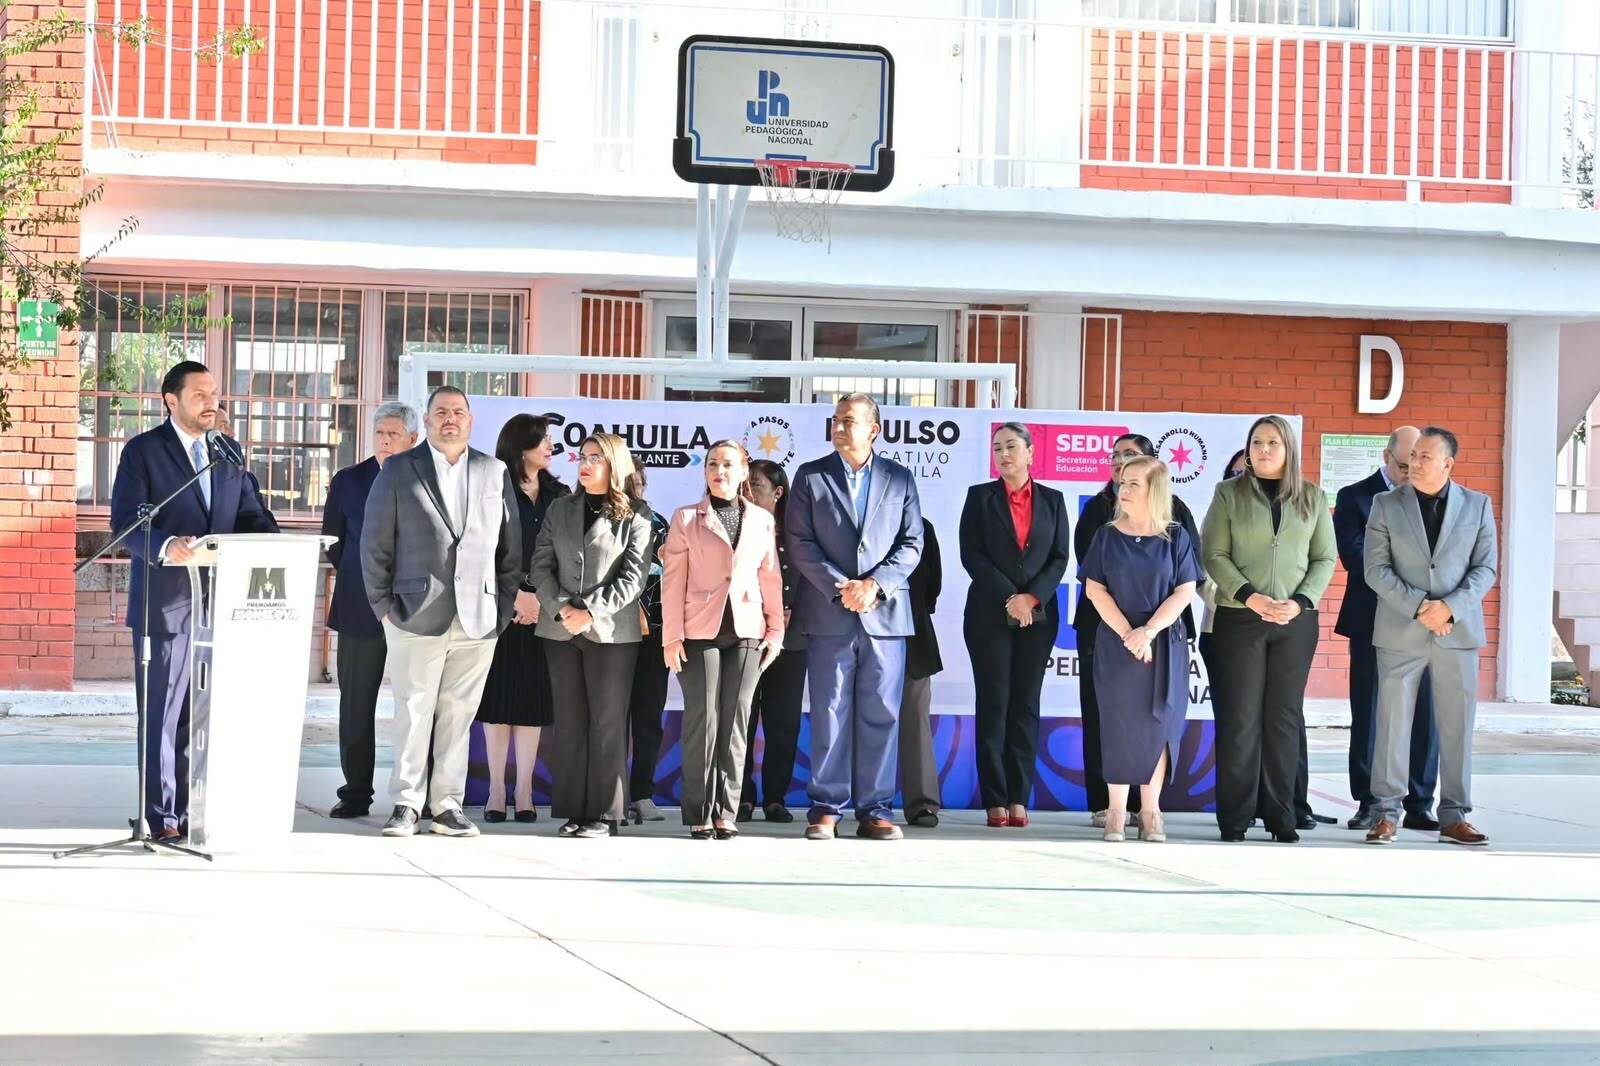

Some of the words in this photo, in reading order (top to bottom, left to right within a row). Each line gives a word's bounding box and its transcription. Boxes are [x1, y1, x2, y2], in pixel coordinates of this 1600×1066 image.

[768, 118, 829, 128] UNIVERSIDAD
[768, 136, 814, 145] NACIONAL
[1358, 335, 1404, 413] D
[758, 416, 790, 429] PASOS
[1189, 431, 1208, 461] HUMANO
